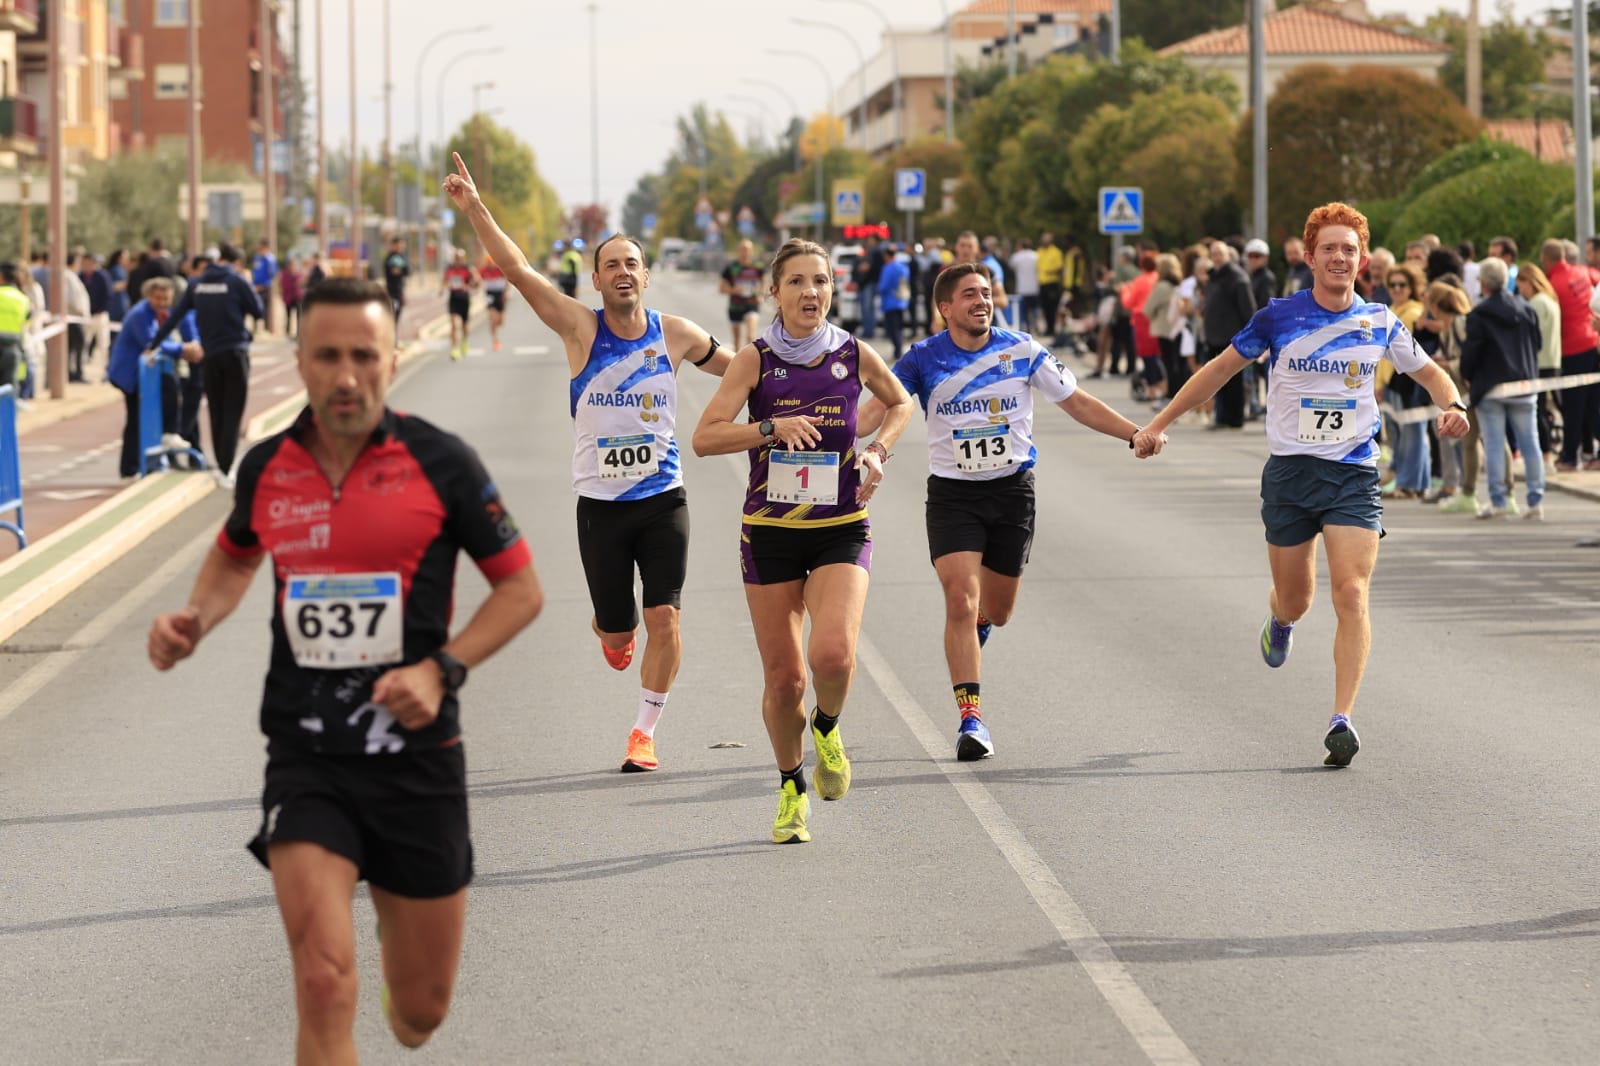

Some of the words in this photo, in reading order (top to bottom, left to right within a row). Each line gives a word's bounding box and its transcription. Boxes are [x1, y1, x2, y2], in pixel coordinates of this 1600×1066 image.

[814, 406, 840, 414] PRIM
[1313, 410, 1344, 430] 73
[604, 445, 651, 468] 400
[959, 436, 1006, 459] 113
[796, 466, 809, 489] 1
[297, 602, 387, 639] 637
